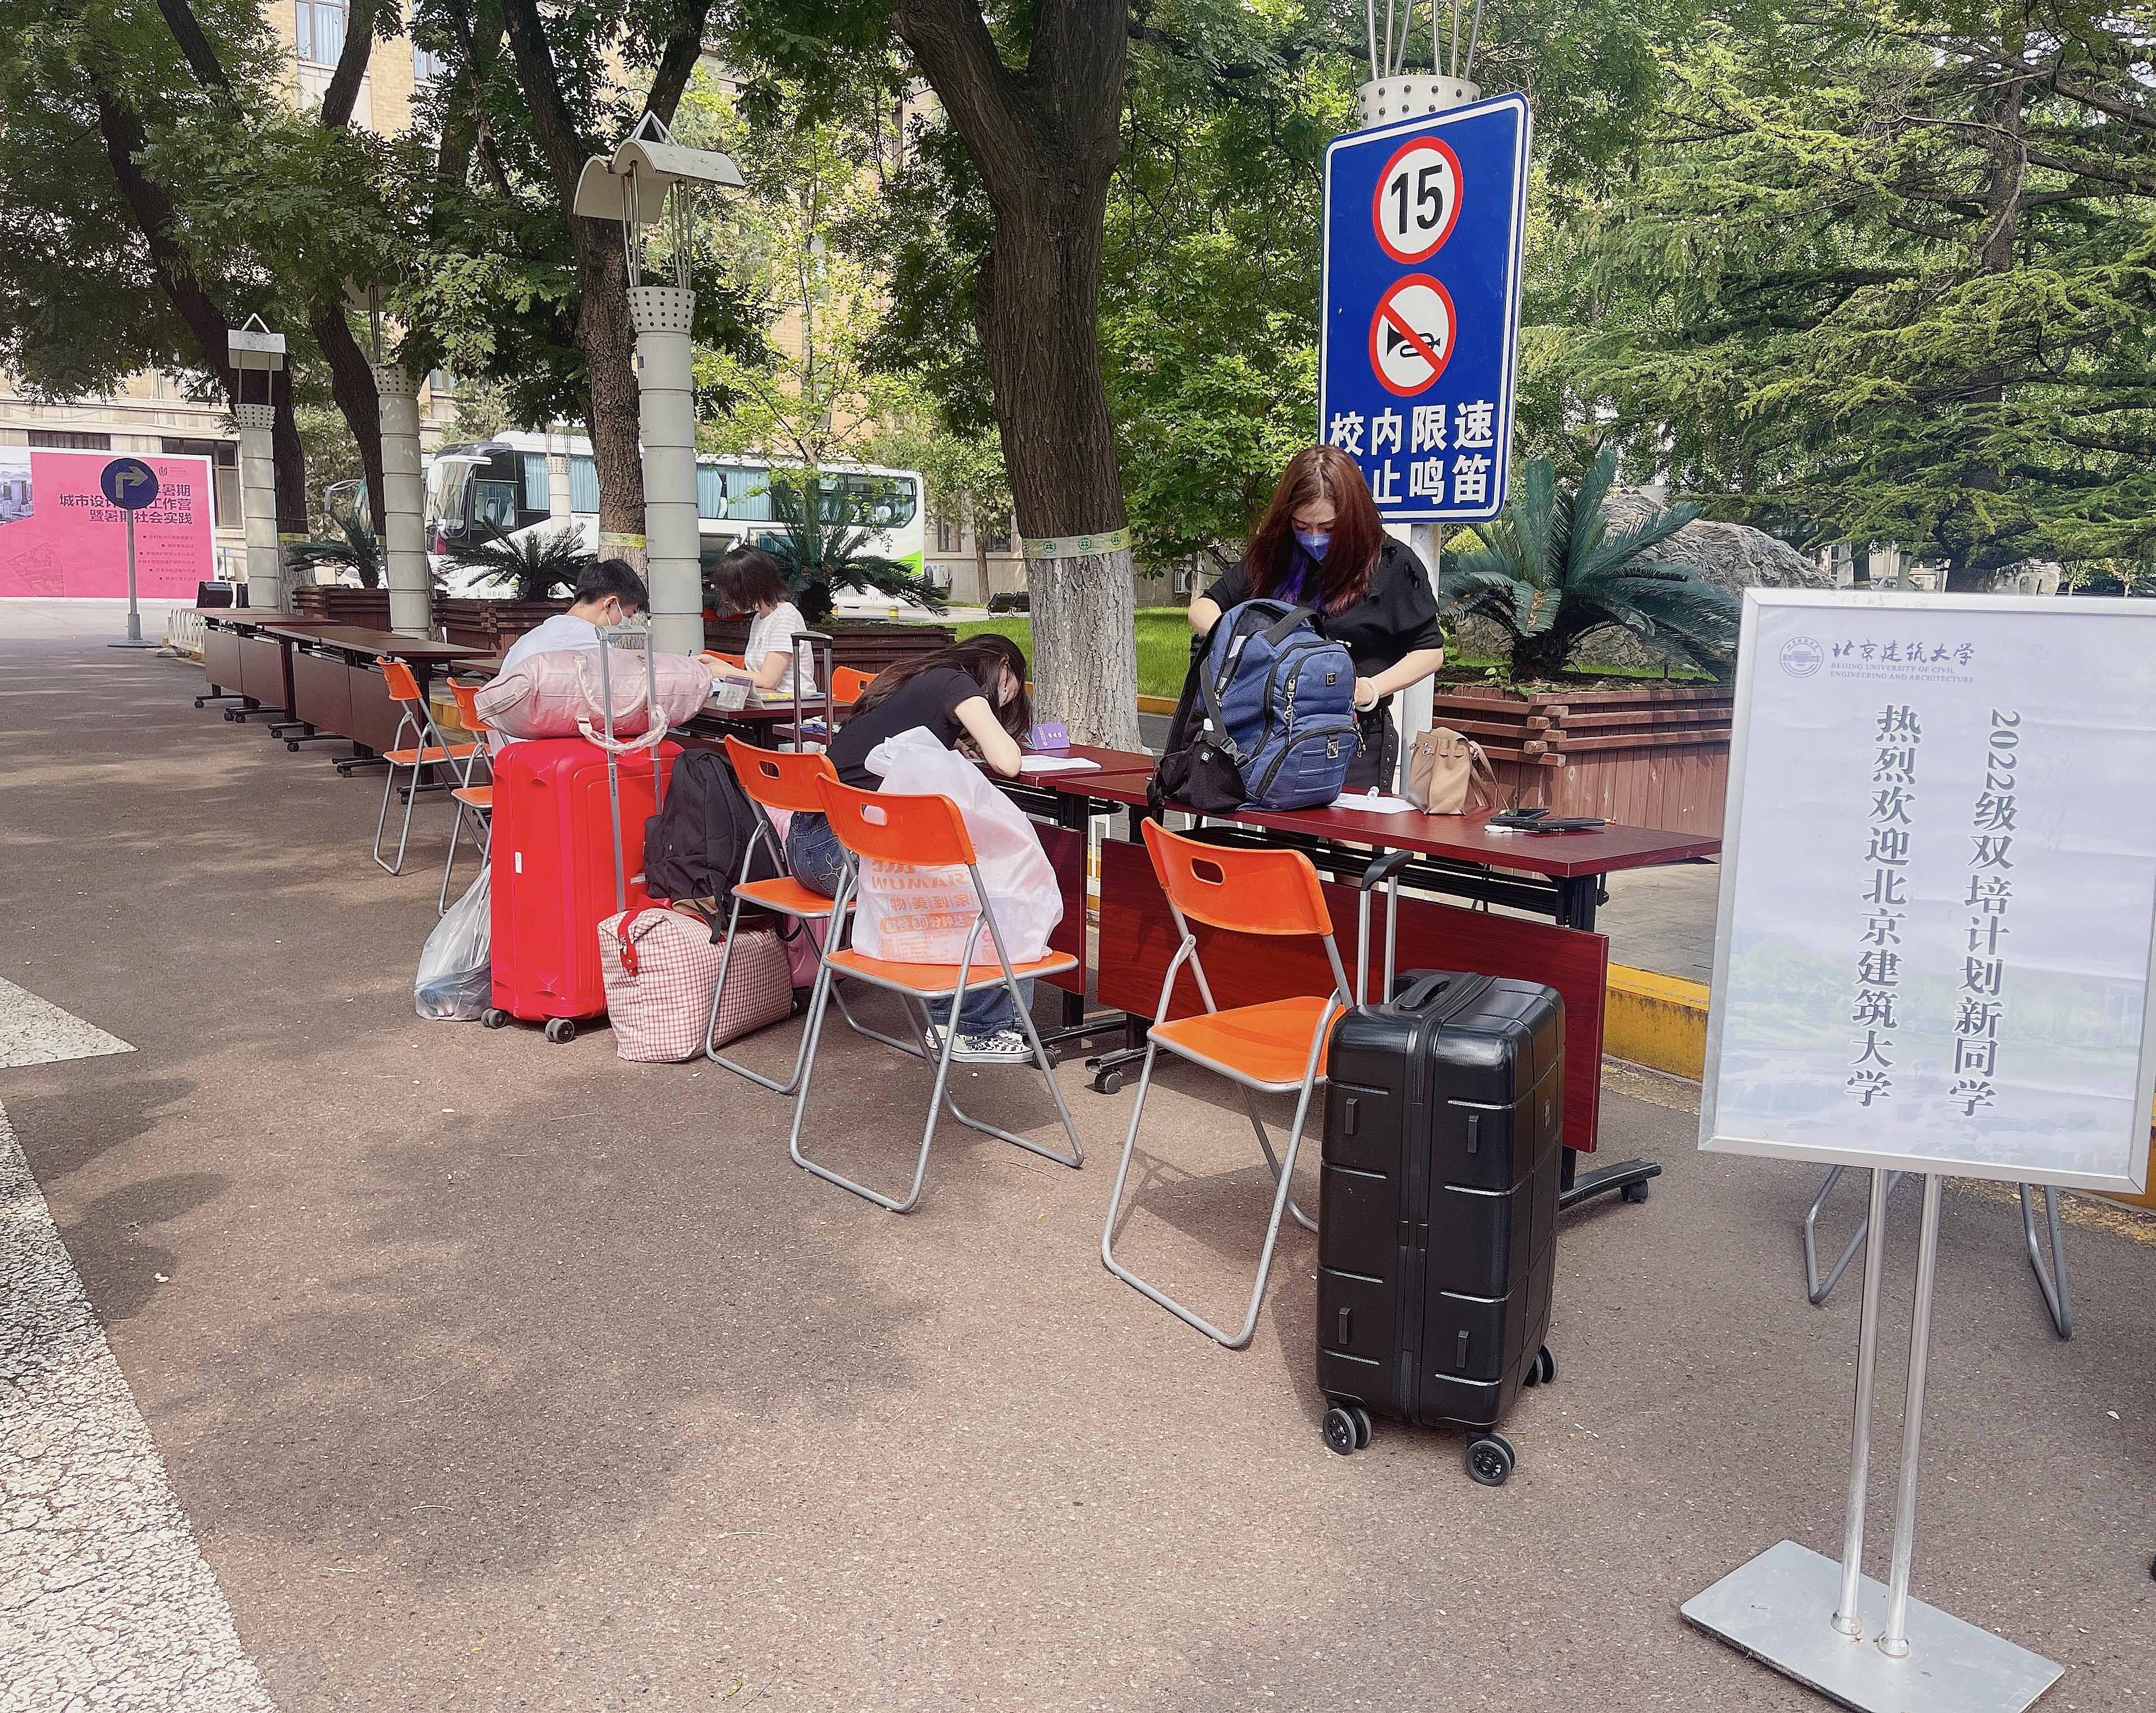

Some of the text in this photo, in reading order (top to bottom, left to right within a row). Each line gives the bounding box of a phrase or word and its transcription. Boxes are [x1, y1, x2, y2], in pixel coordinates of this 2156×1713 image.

[1391, 164, 1443, 235] 15
[1329, 399, 1494, 456] 校内限速
[159, 484, 191, 496] 暑期
[1359, 454, 1491, 505] 止鸣笛
[1830, 671, 1886, 679] ENGINEERING
[1909, 674, 1975, 683] ARCHITECTURE
[1831, 638, 1975, 667] 北京建筑大学
[1831, 662, 1863, 671] BEIJING
[1865, 663, 1916, 672] UNIVERSITY
[1845, 704, 1922, 1107] 热烈欢迎北京建筑大学
[1948, 708, 2021, 1117] 2022级双培计划新同学
